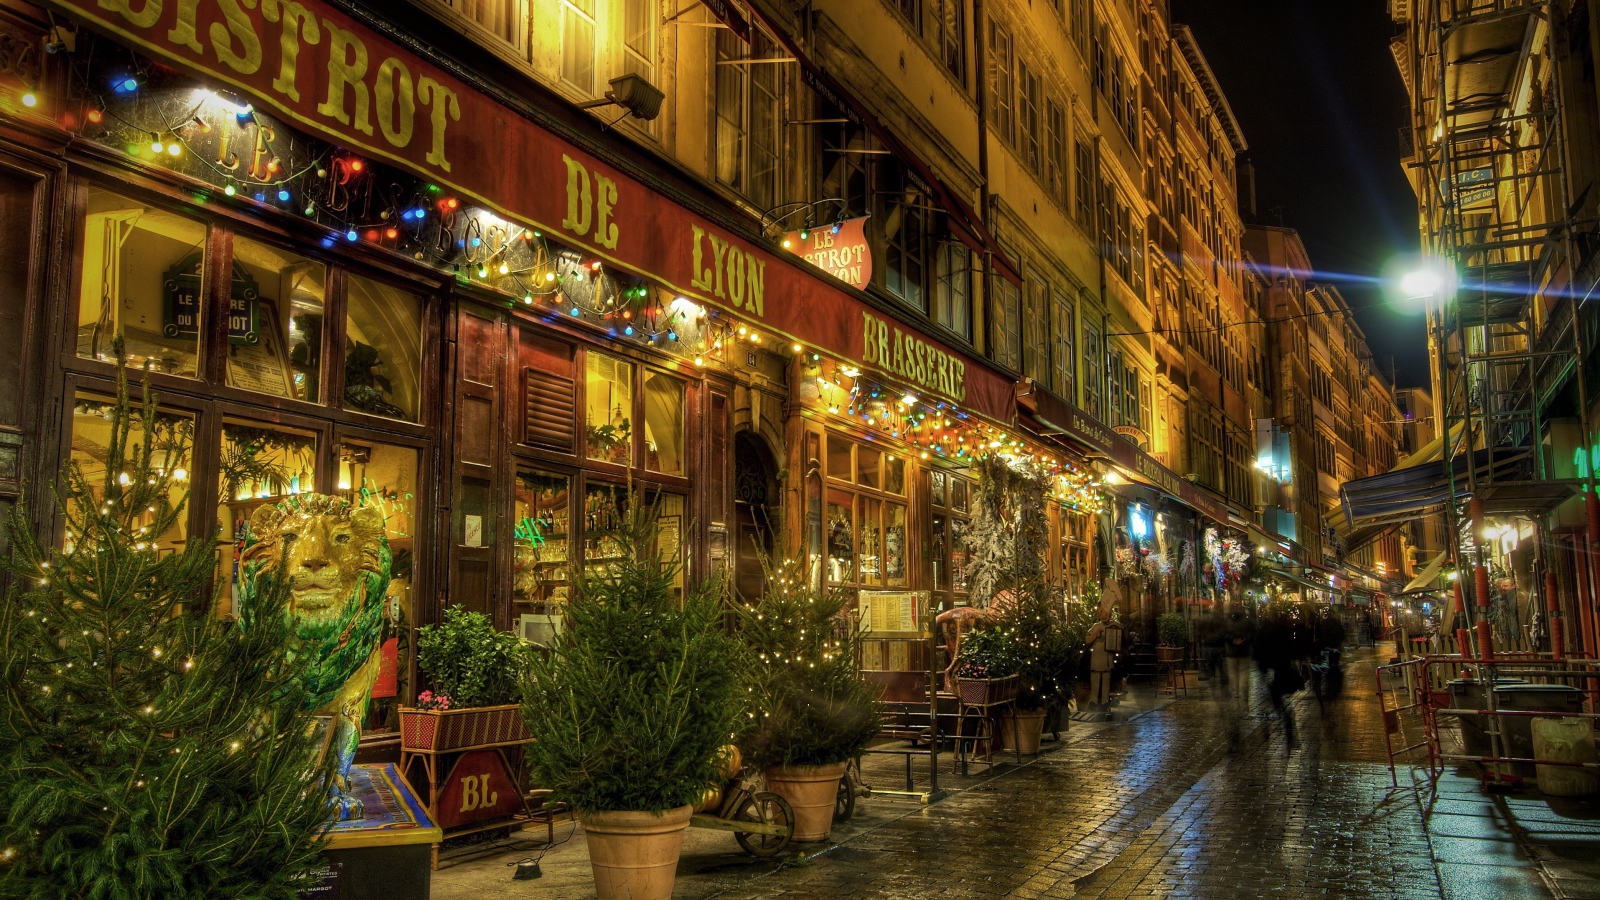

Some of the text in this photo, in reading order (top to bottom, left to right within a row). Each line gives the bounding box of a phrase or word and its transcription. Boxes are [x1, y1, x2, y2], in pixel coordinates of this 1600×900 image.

[97, 0, 966, 403] STROT DE LYON BRASSERIE
[813, 230, 834, 250] LE
[800, 244, 866, 270] STROT
[179, 294, 192, 305] LE
[178, 314, 191, 325] DU
[748, 353, 756, 367] 64
[1114, 427, 1140, 437] TAURANT
[459, 773, 498, 813] BL
